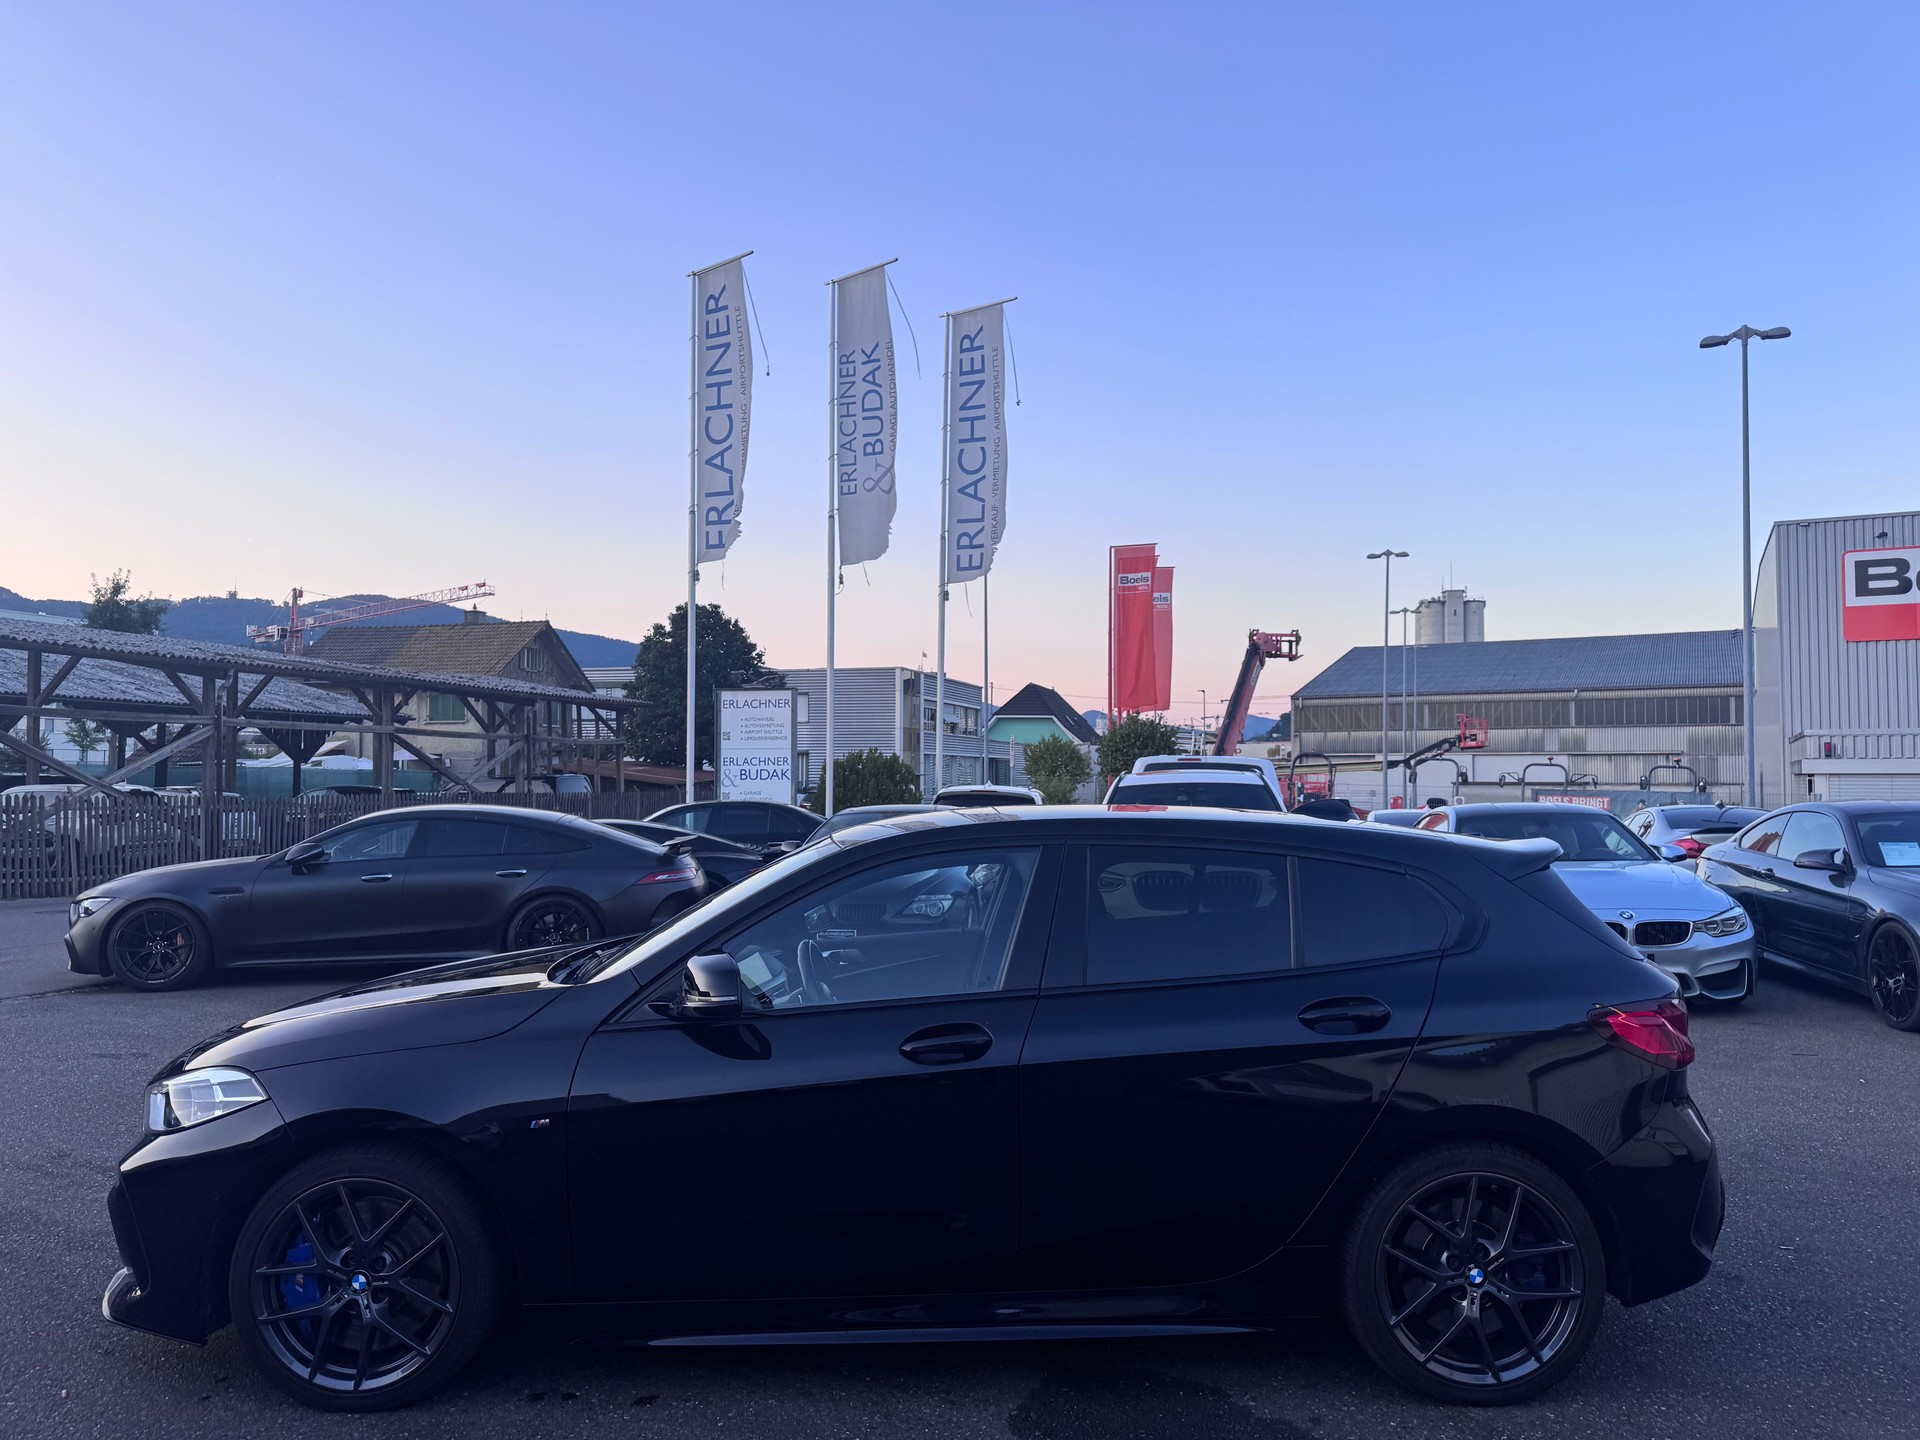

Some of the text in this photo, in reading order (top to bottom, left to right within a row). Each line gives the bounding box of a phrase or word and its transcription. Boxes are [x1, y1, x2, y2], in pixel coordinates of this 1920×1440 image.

[735, 305, 747, 396] AIRPORTSHUTTLE
[705, 284, 733, 549] ERLACHNER
[839, 349, 858, 496] ERLACHNER
[860, 341, 895, 495] & BUDAK
[889, 409, 897, 452] GARAGE
[956, 324, 987, 573] ERLACHNER
[990, 345, 1001, 546] VERKAUF VERMIETUNG AIRPORTSHUTTLE
[1119, 575, 1149, 584] Boels
[1153, 594, 1169, 603] els
[1854, 557, 1920, 598] B
[722, 699, 790, 708] ERLACHNER
[721, 768, 790, 788] & BUDAK
[722, 757, 789, 767] ERLACHNER
[1572, 797, 1609, 808] BRINGT
